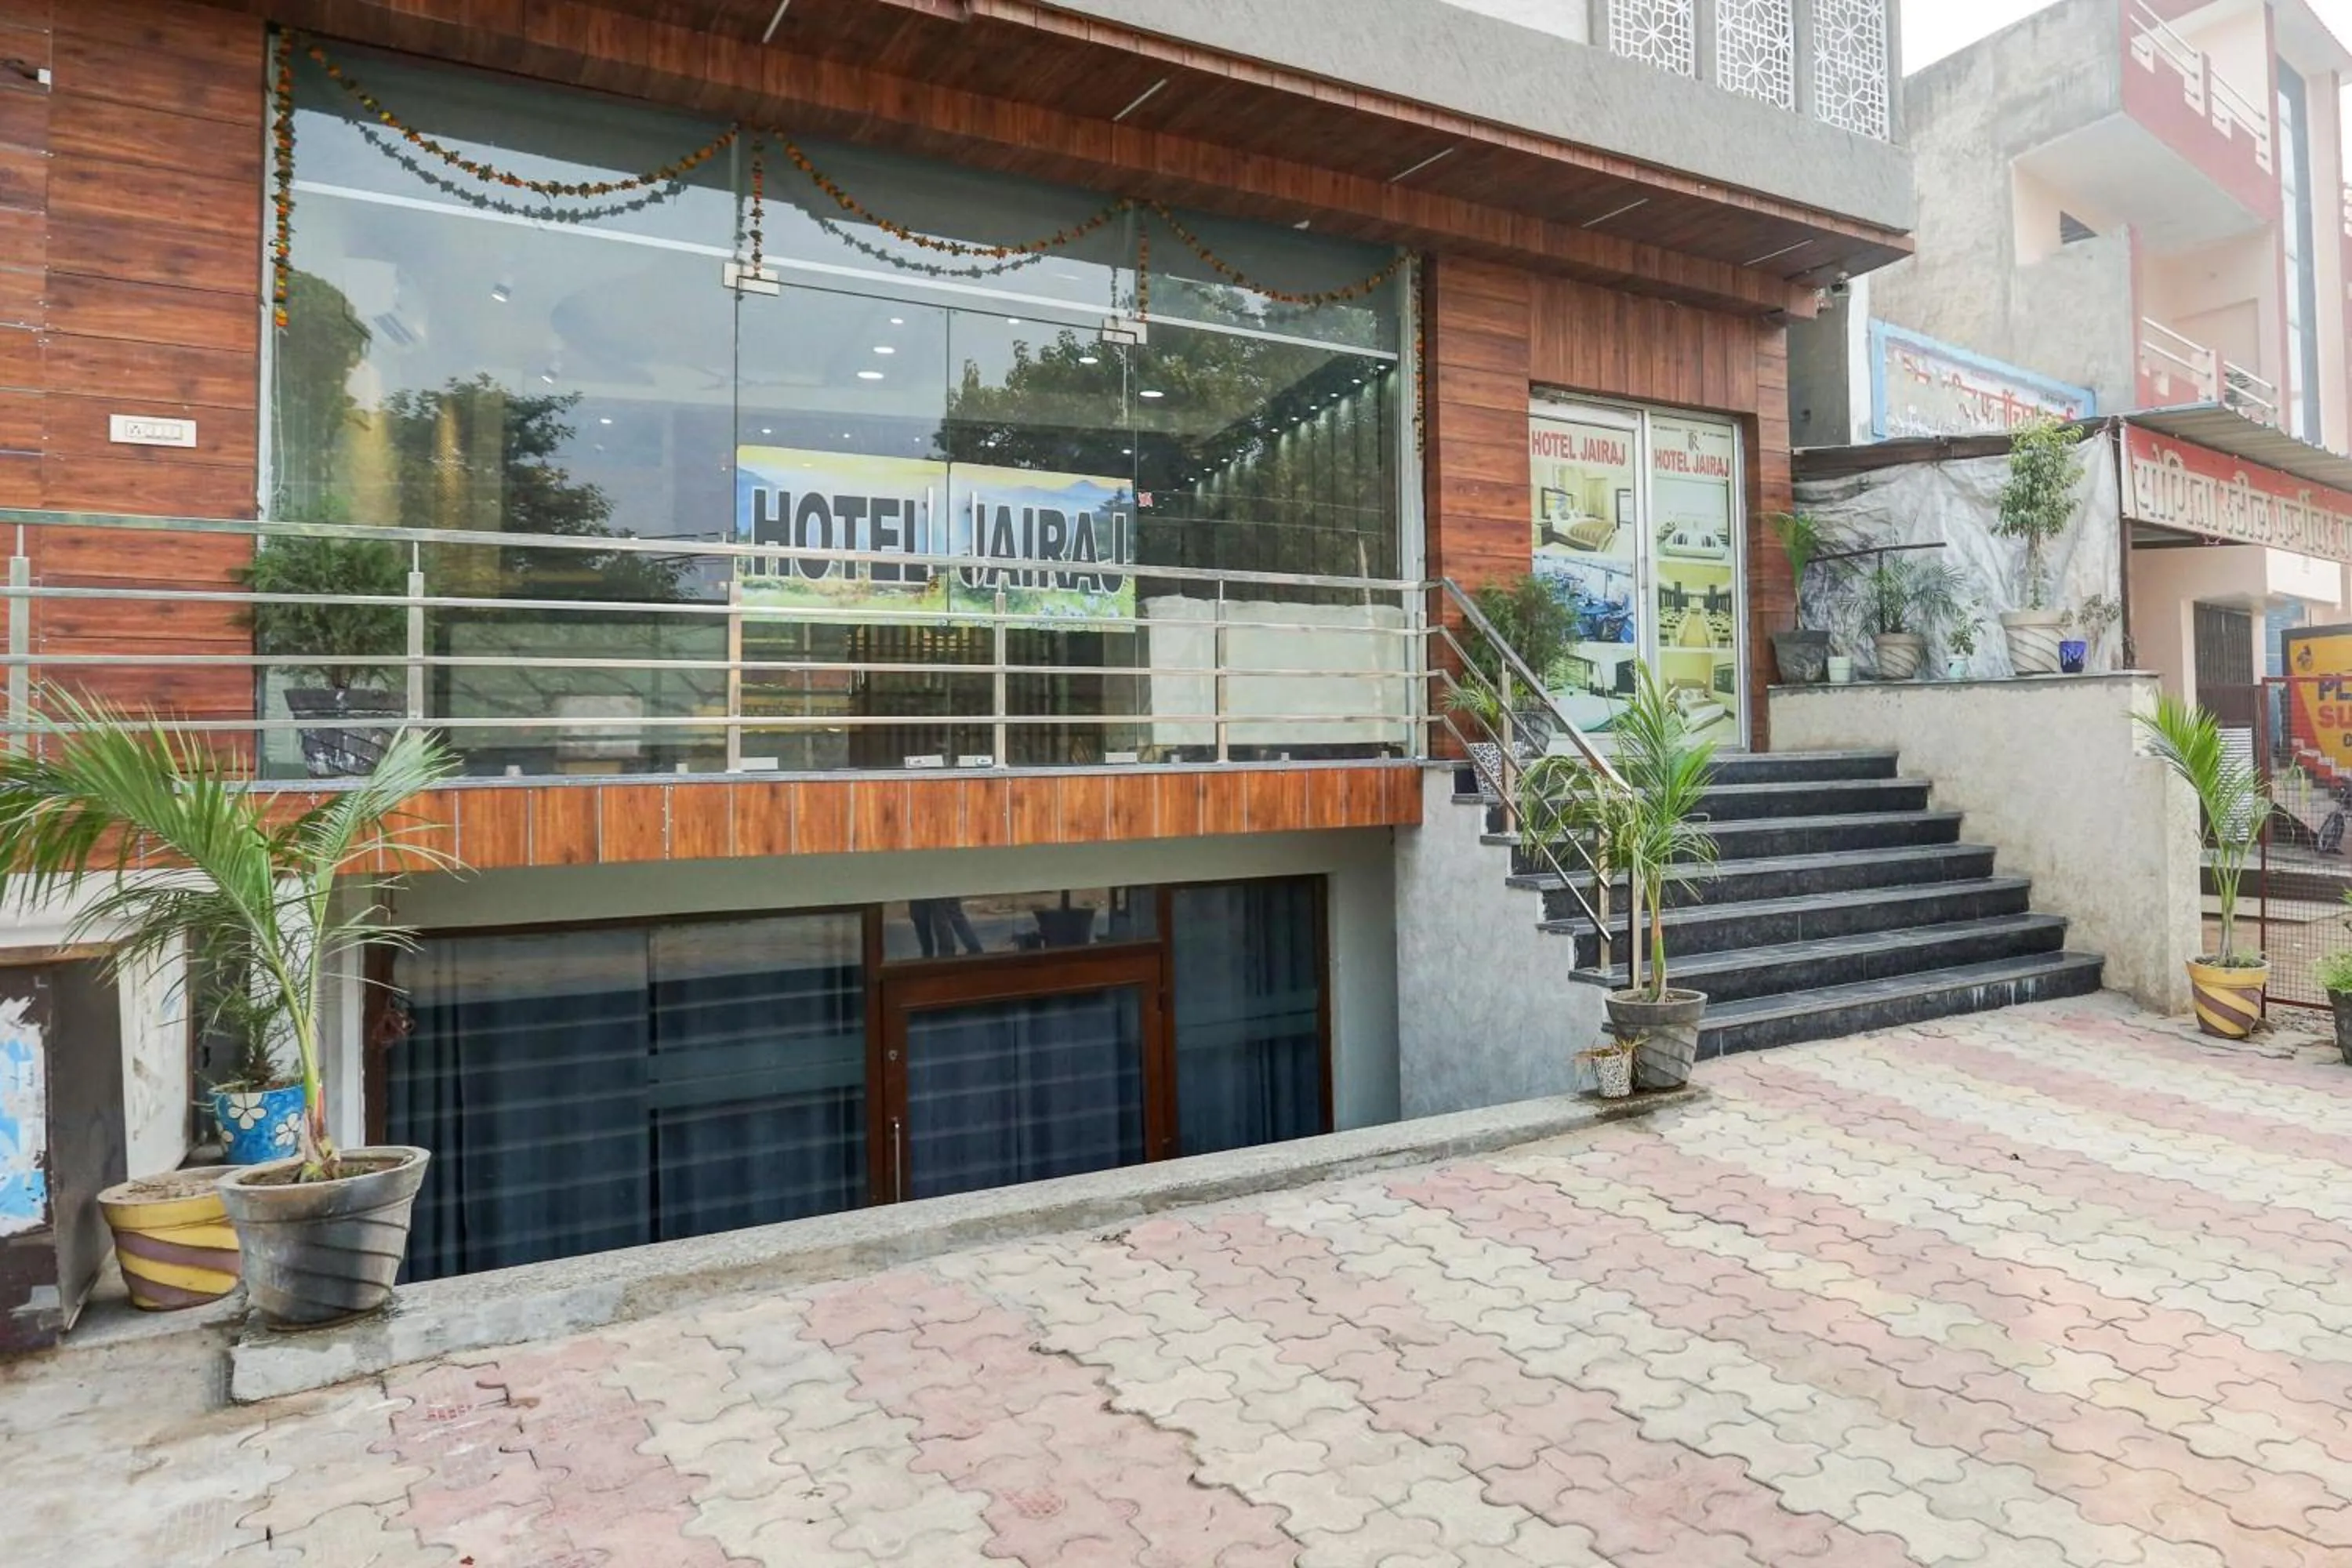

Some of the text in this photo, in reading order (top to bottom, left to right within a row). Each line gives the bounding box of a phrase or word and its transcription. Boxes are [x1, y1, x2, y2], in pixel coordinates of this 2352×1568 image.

[1531, 430, 1626, 466] HOTEL JAIRAJ
[1654, 448, 1730, 477] HOTEL JAIRAJ
[753, 487, 1127, 593] HOTEL JAIRAJ
